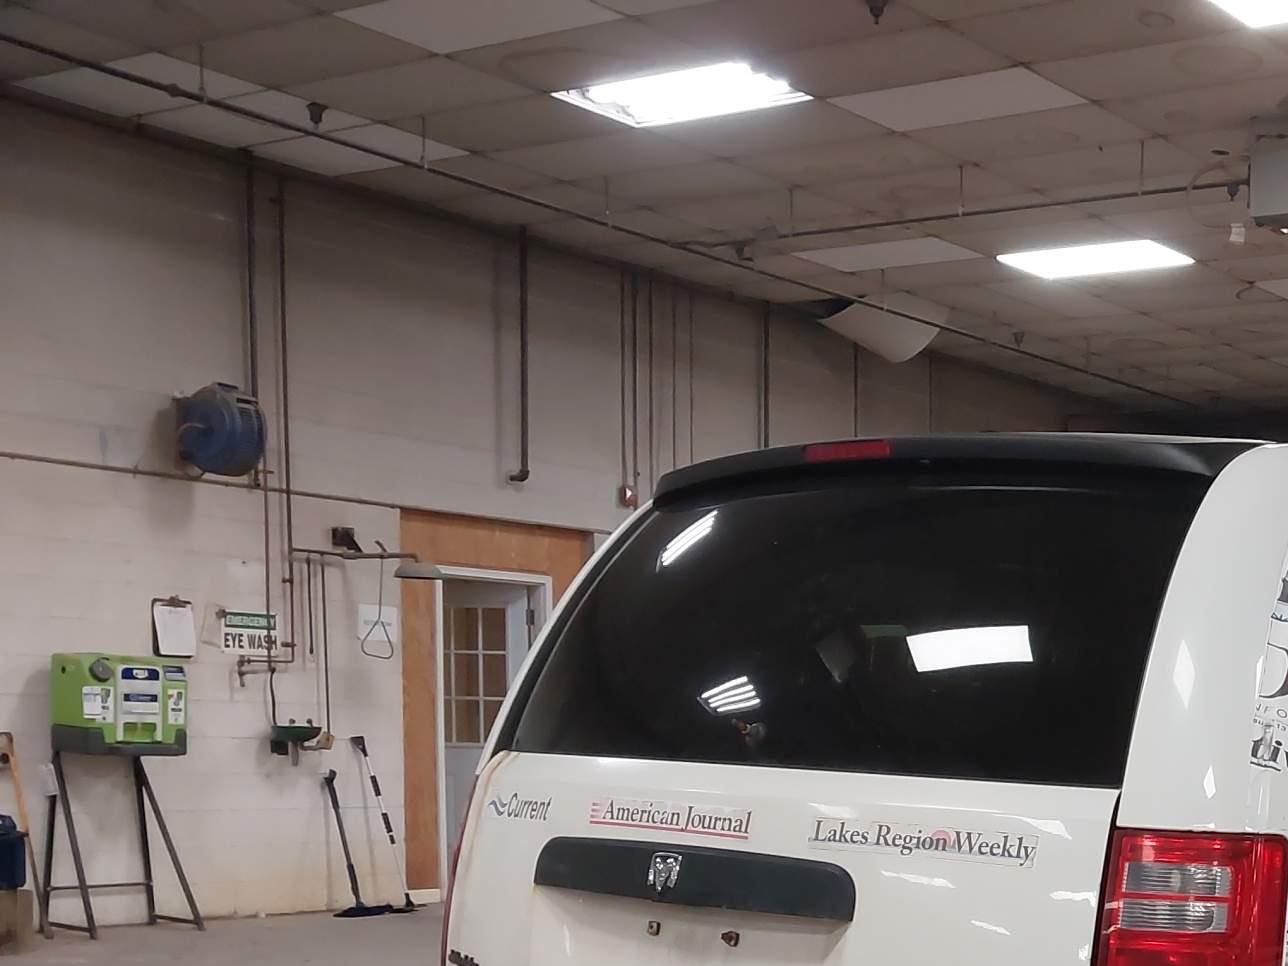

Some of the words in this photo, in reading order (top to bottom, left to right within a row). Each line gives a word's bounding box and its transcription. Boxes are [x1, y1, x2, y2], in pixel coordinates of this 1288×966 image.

[224, 632, 244, 648] EYE
[247, 634, 278, 650] WASH
[506, 793, 552, 821] Current
[602, 799, 680, 827] American
[684, 805, 751, 834] Journal
[813, 819, 869, 845] Lakes
[874, 823, 948, 856] Region
[954, 830, 1037, 867] Weekly
